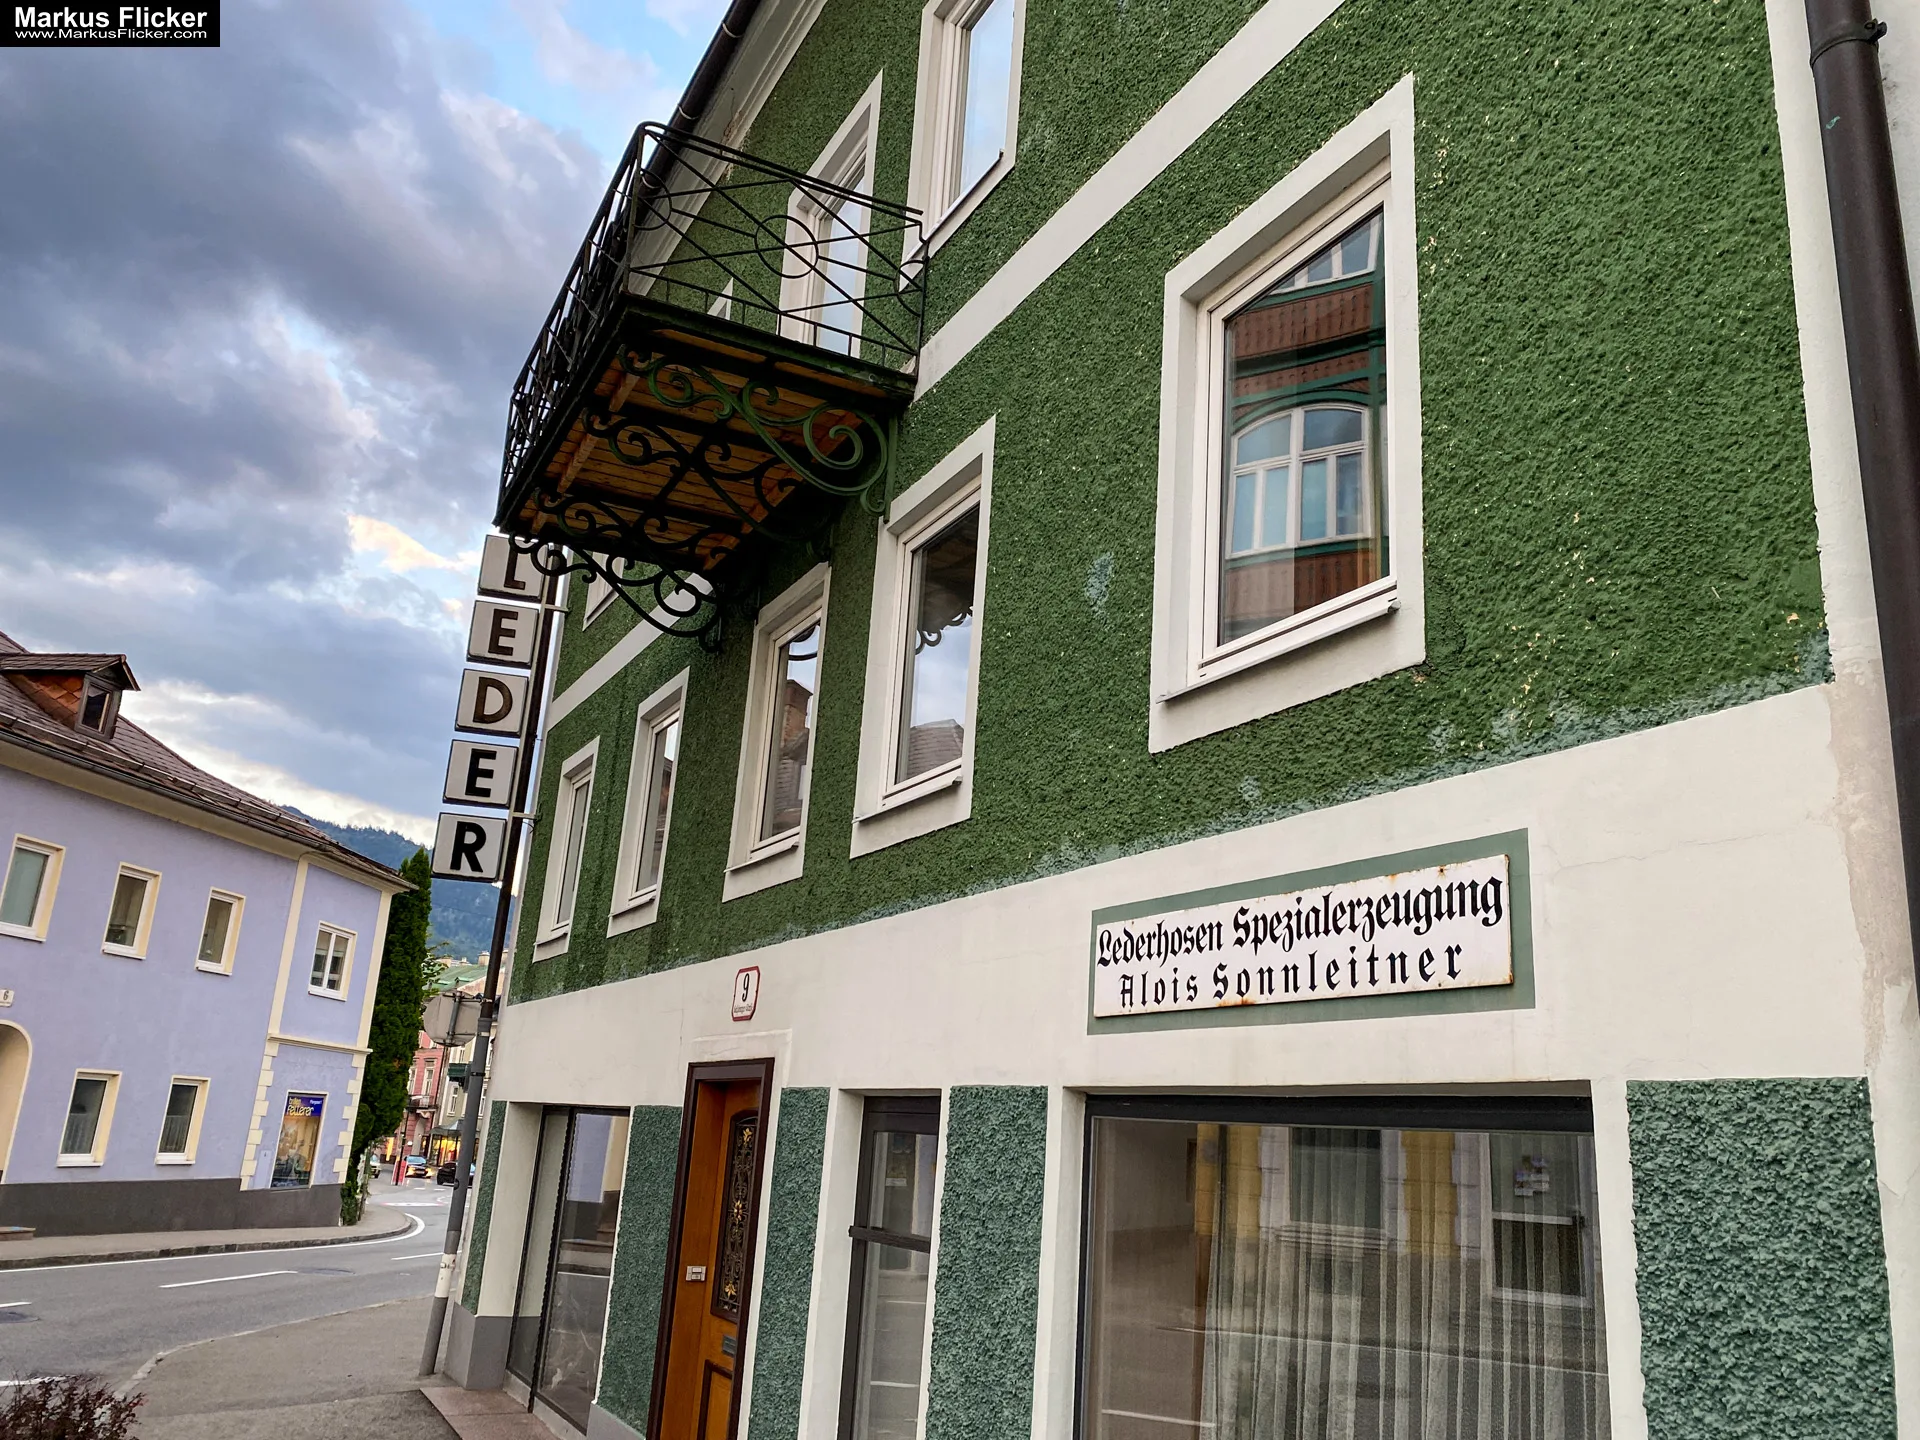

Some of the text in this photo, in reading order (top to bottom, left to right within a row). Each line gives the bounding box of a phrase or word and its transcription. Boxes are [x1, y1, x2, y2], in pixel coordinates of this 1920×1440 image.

[450, 543, 525, 873] LEDER
[1097, 875, 1504, 967] Lederhosen Spezialerzeugung
[742, 973, 750, 1002] 9
[1118, 942, 1464, 1009] Alois Sonnleitner
